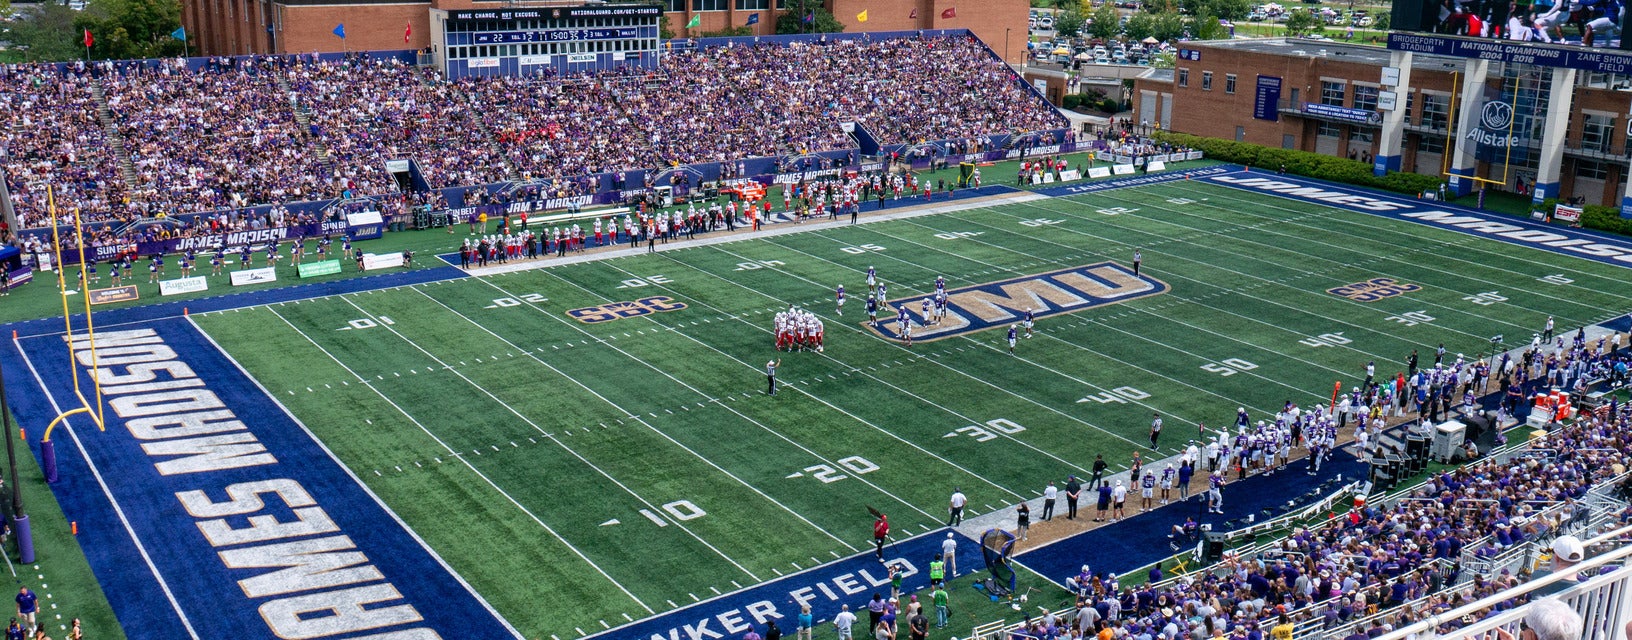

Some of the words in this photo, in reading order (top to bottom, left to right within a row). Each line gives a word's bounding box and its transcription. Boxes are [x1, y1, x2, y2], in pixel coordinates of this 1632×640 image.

[1392, 34, 1444, 46] BRIDGEFORTH
[1400, 42, 1434, 52] STADIUM
[1460, 42, 1503, 52] NATIONAL
[1506, 46, 1560, 58] CHAMPIONS
[1480, 51, 1502, 60] 2004
[1512, 55, 1534, 63] 2016
[1577, 53, 1601, 62] ZANE
[1603, 56, 1632, 65] SHOW
[1599, 63, 1624, 72] FIELD
[1466, 128, 1518, 147] Allstate
[1006, 149, 1029, 158] JAMS
[1030, 145, 1060, 155] MADISON
[773, 172, 802, 184] JAMES
[1066, 184, 1113, 192] ZANE
[461, 207, 477, 215] BELT
[507, 200, 543, 213] JAMS
[546, 195, 593, 209] MADSON
[321, 222, 338, 230] SUN
[1212, 176, 1415, 212] JAMES
[1400, 211, 1632, 263] MADIS
[356, 227, 377, 236] JMU
[176, 235, 222, 250] JAMES
[227, 228, 287, 244] MADISON
[97, 246, 116, 256] SUN
[840, 244, 887, 254] 50
[622, 274, 674, 287] 30
[493, 293, 548, 307] 20
[862, 262, 1168, 341] JMU
[1462, 292, 1509, 306] 20
[565, 296, 688, 324] SBC
[348, 316, 395, 329] 10
[1385, 312, 1436, 326] 30
[1298, 333, 1353, 348] 40
[1200, 358, 1259, 377] 50
[61, 328, 279, 476] MADISON
[1086, 386, 1152, 404] 40
[954, 418, 1026, 442] 30
[803, 456, 880, 484] 20
[638, 500, 707, 527] 10
[789, 557, 918, 609] FIELD
